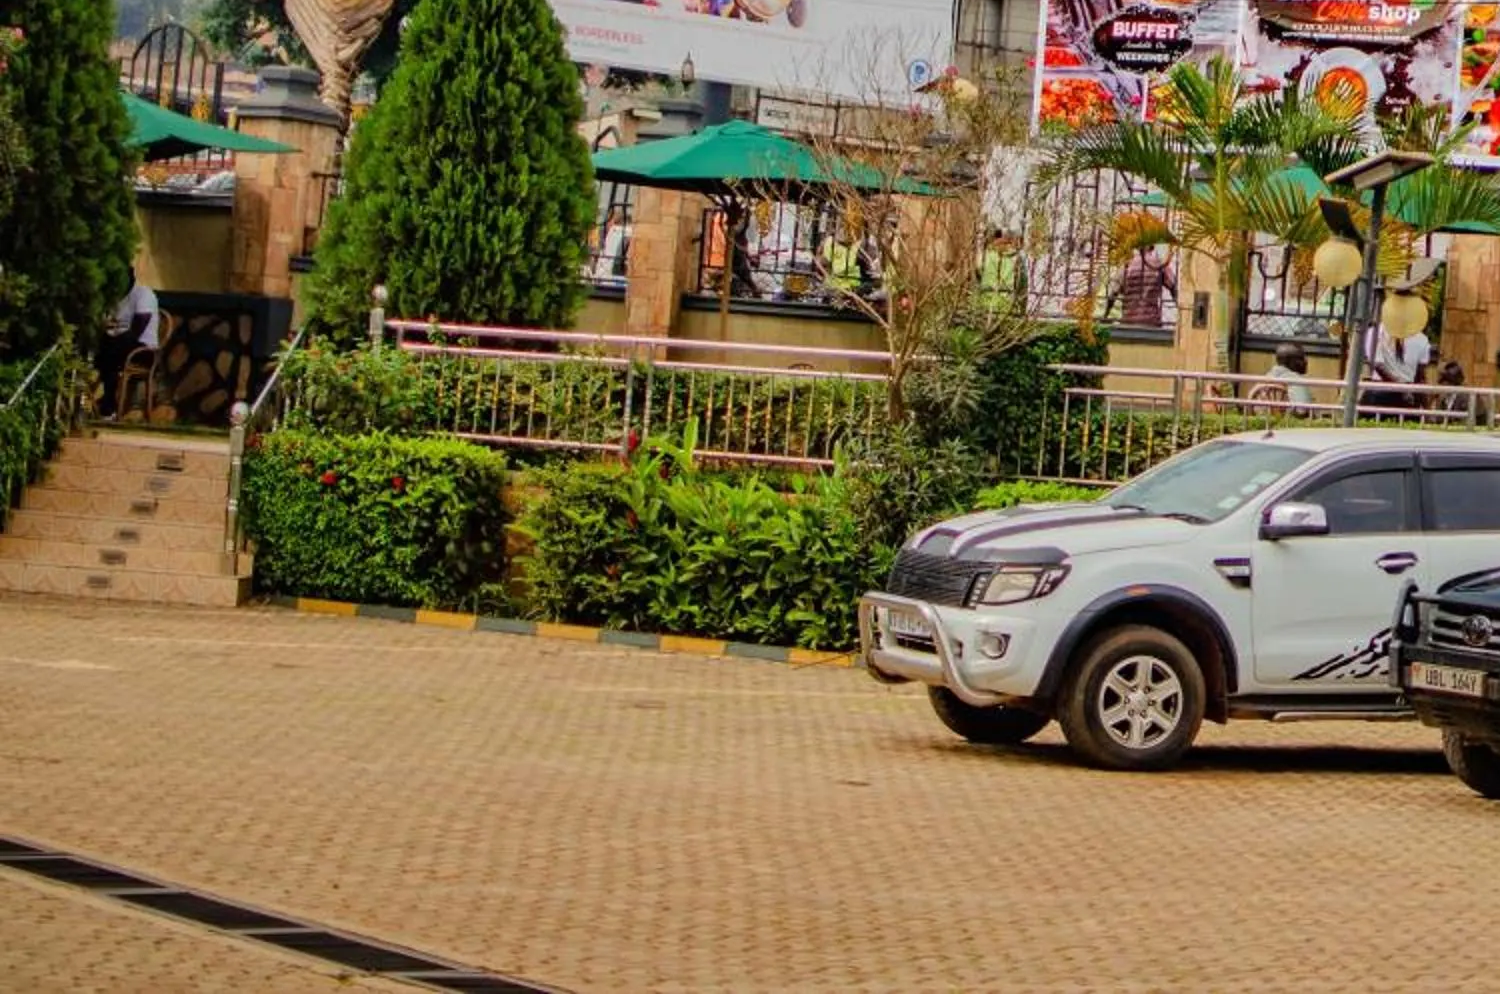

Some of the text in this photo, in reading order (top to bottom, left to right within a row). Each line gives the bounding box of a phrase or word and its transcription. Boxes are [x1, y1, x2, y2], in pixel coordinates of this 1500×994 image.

[1368, 3, 1421, 26] shop
[1112, 20, 1179, 39] BUFFET
[1425, 668, 1447, 687] UBL
